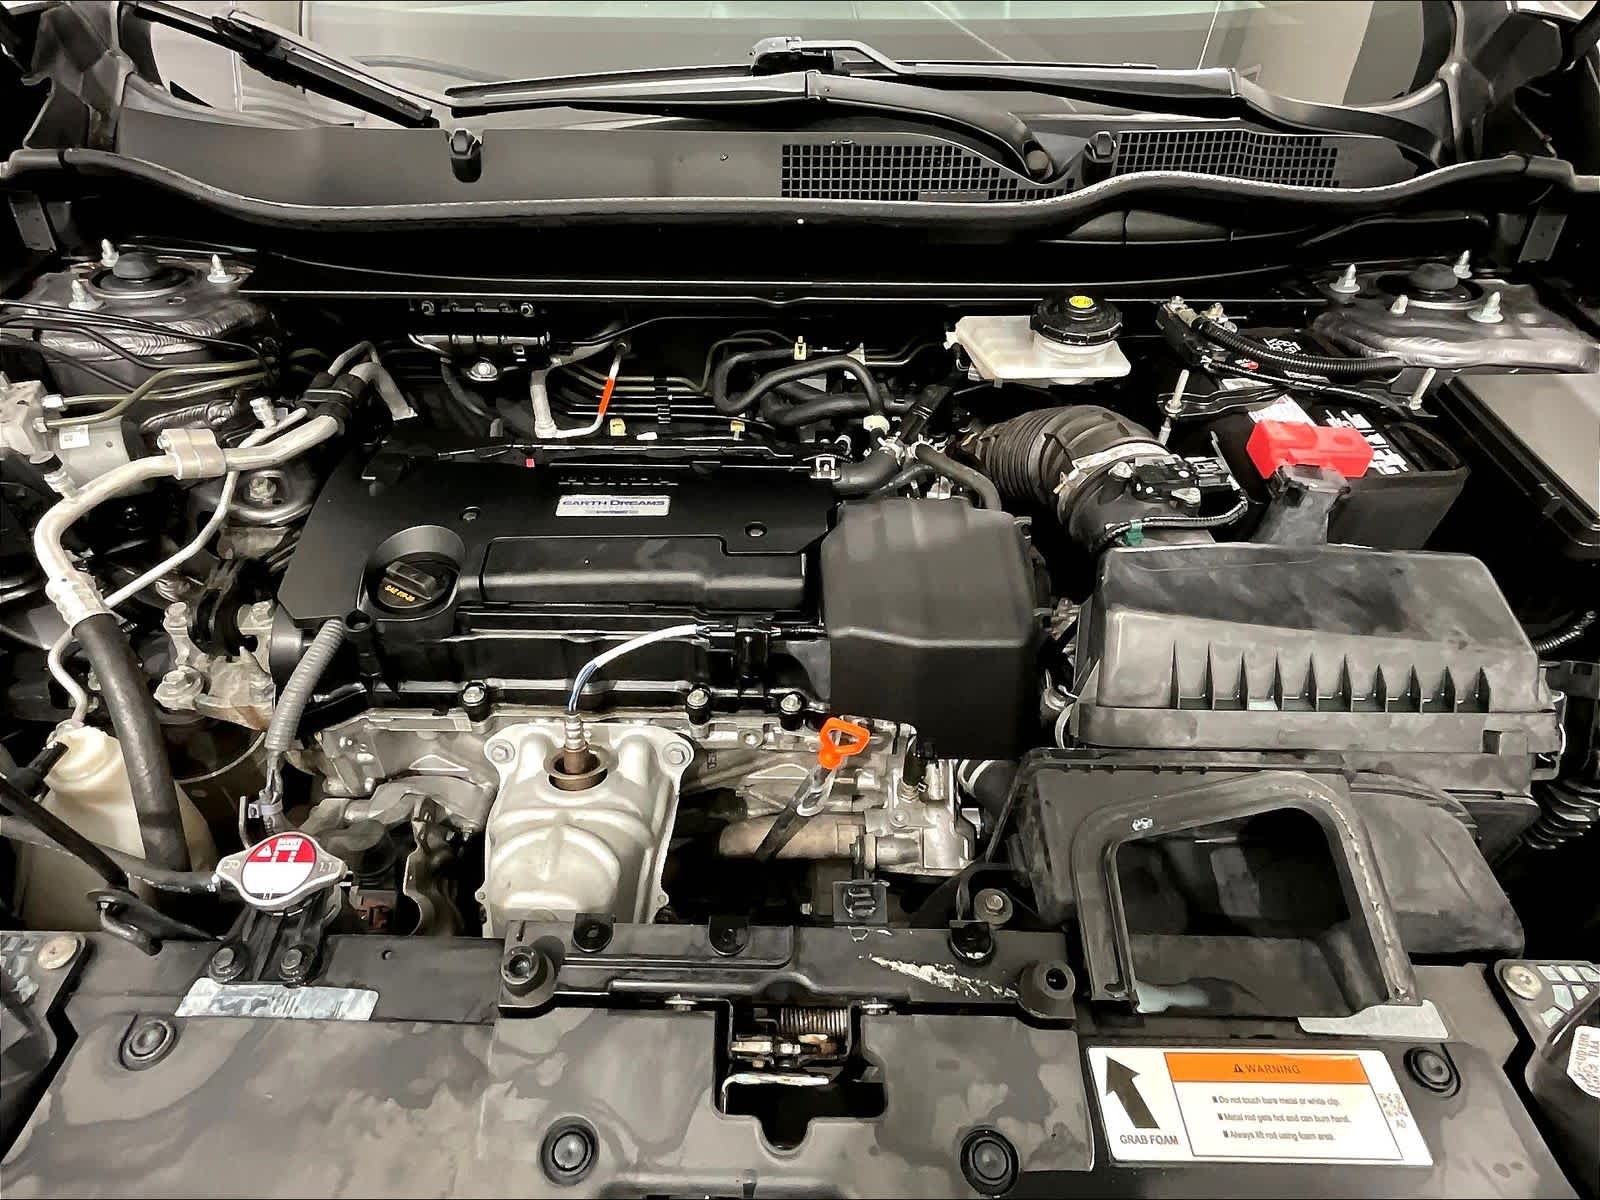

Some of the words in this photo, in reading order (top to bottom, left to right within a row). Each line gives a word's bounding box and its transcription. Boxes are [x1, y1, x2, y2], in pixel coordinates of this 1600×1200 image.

[1246, 1064, 1301, 1074] WARNING
[1218, 1095, 1228, 1104] Do
[1230, 1096, 1241, 1104] not
[1242, 1096, 1261, 1105] touch
[1262, 1097, 1278, 1105] bare
[1307, 1098, 1326, 1106] white
[1223, 1112, 1243, 1121] Metal
[1244, 1113, 1256, 1121] rod
[1257, 1114, 1272, 1123] gets
[1273, 1113, 1285, 1122] hot
[1286, 1114, 1299, 1122] and
[1314, 1114, 1330, 1123] burn
[1120, 1134, 1148, 1144] GRAB
[1150, 1134, 1179, 1144] FOAM
[1230, 1130, 1254, 1140] Always
[1265, 1131, 1278, 1140] rod
[1279, 1132, 1298, 1142] using
